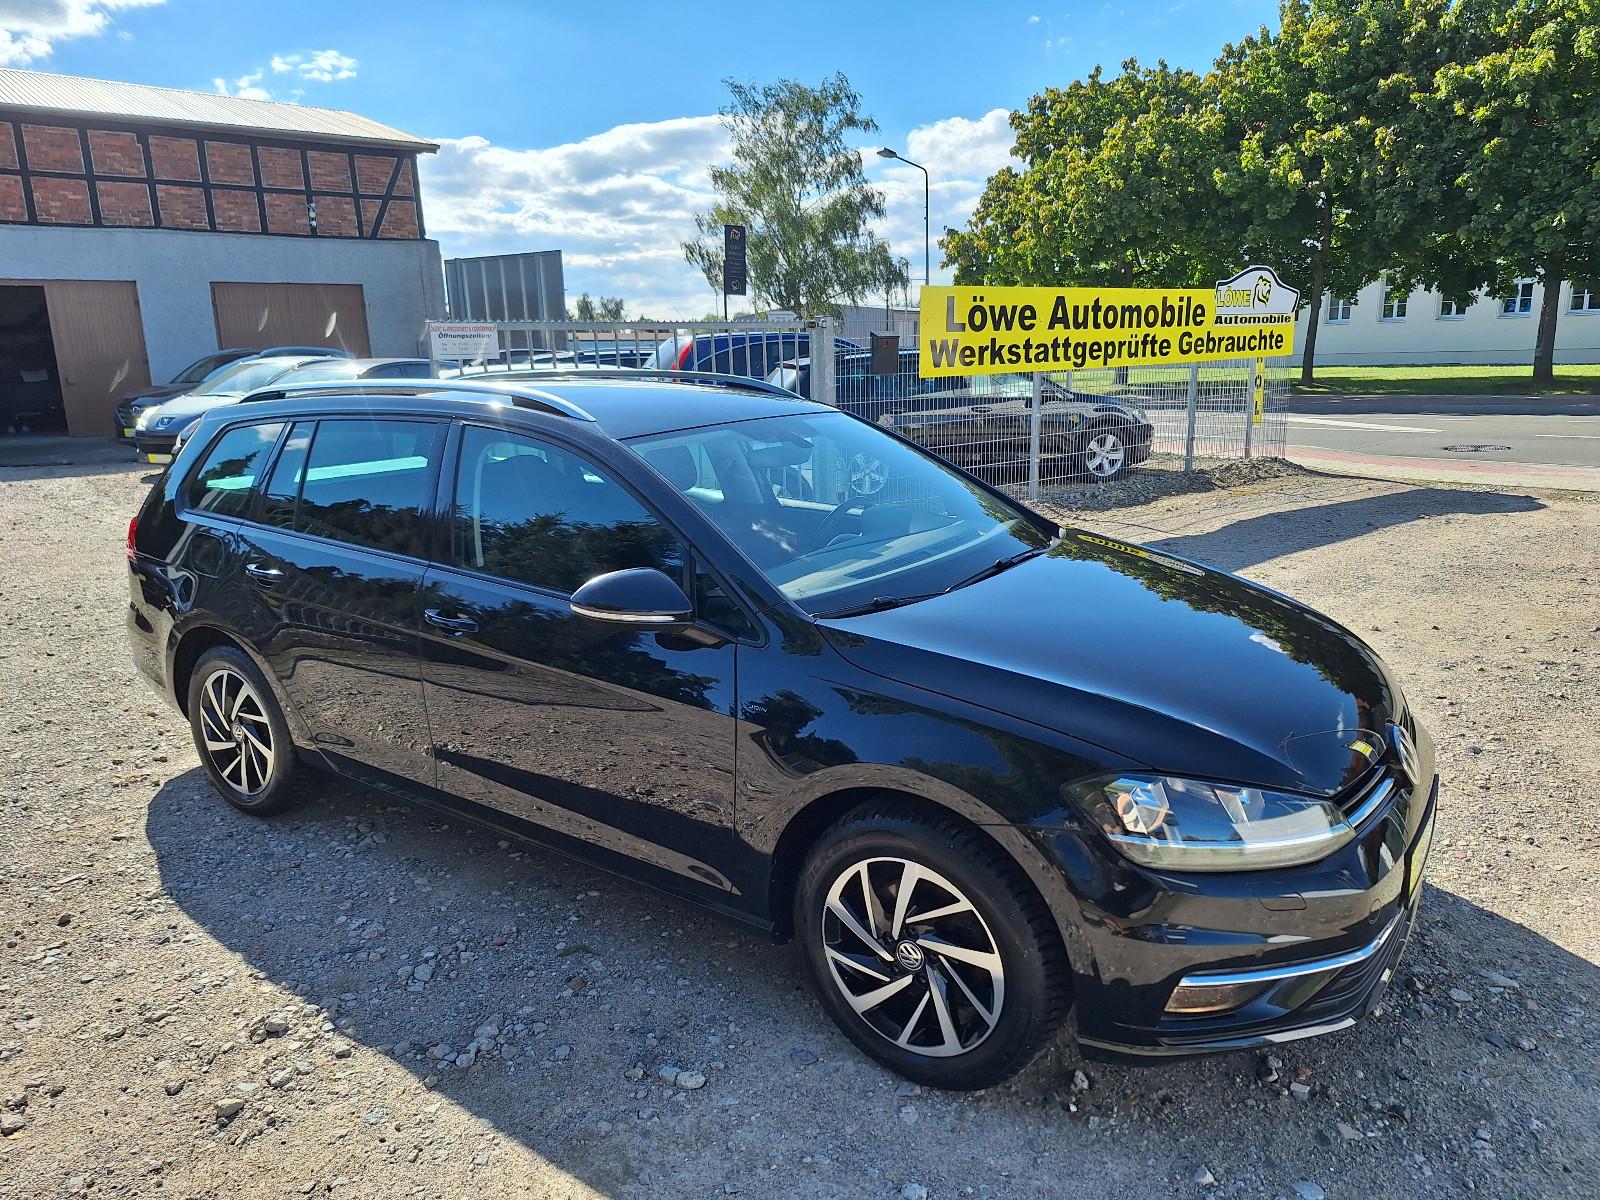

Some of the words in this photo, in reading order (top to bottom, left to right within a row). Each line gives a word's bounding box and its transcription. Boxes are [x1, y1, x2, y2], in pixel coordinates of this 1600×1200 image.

[1216, 286, 1252, 308] LÖWE
[946, 295, 1037, 333] Löwe
[1047, 295, 1206, 332] Automobile
[1214, 314, 1292, 325] Automobile
[930, 334, 1172, 369] Werkstattgeprüfte
[1177, 329, 1285, 355] Gebrauchte
